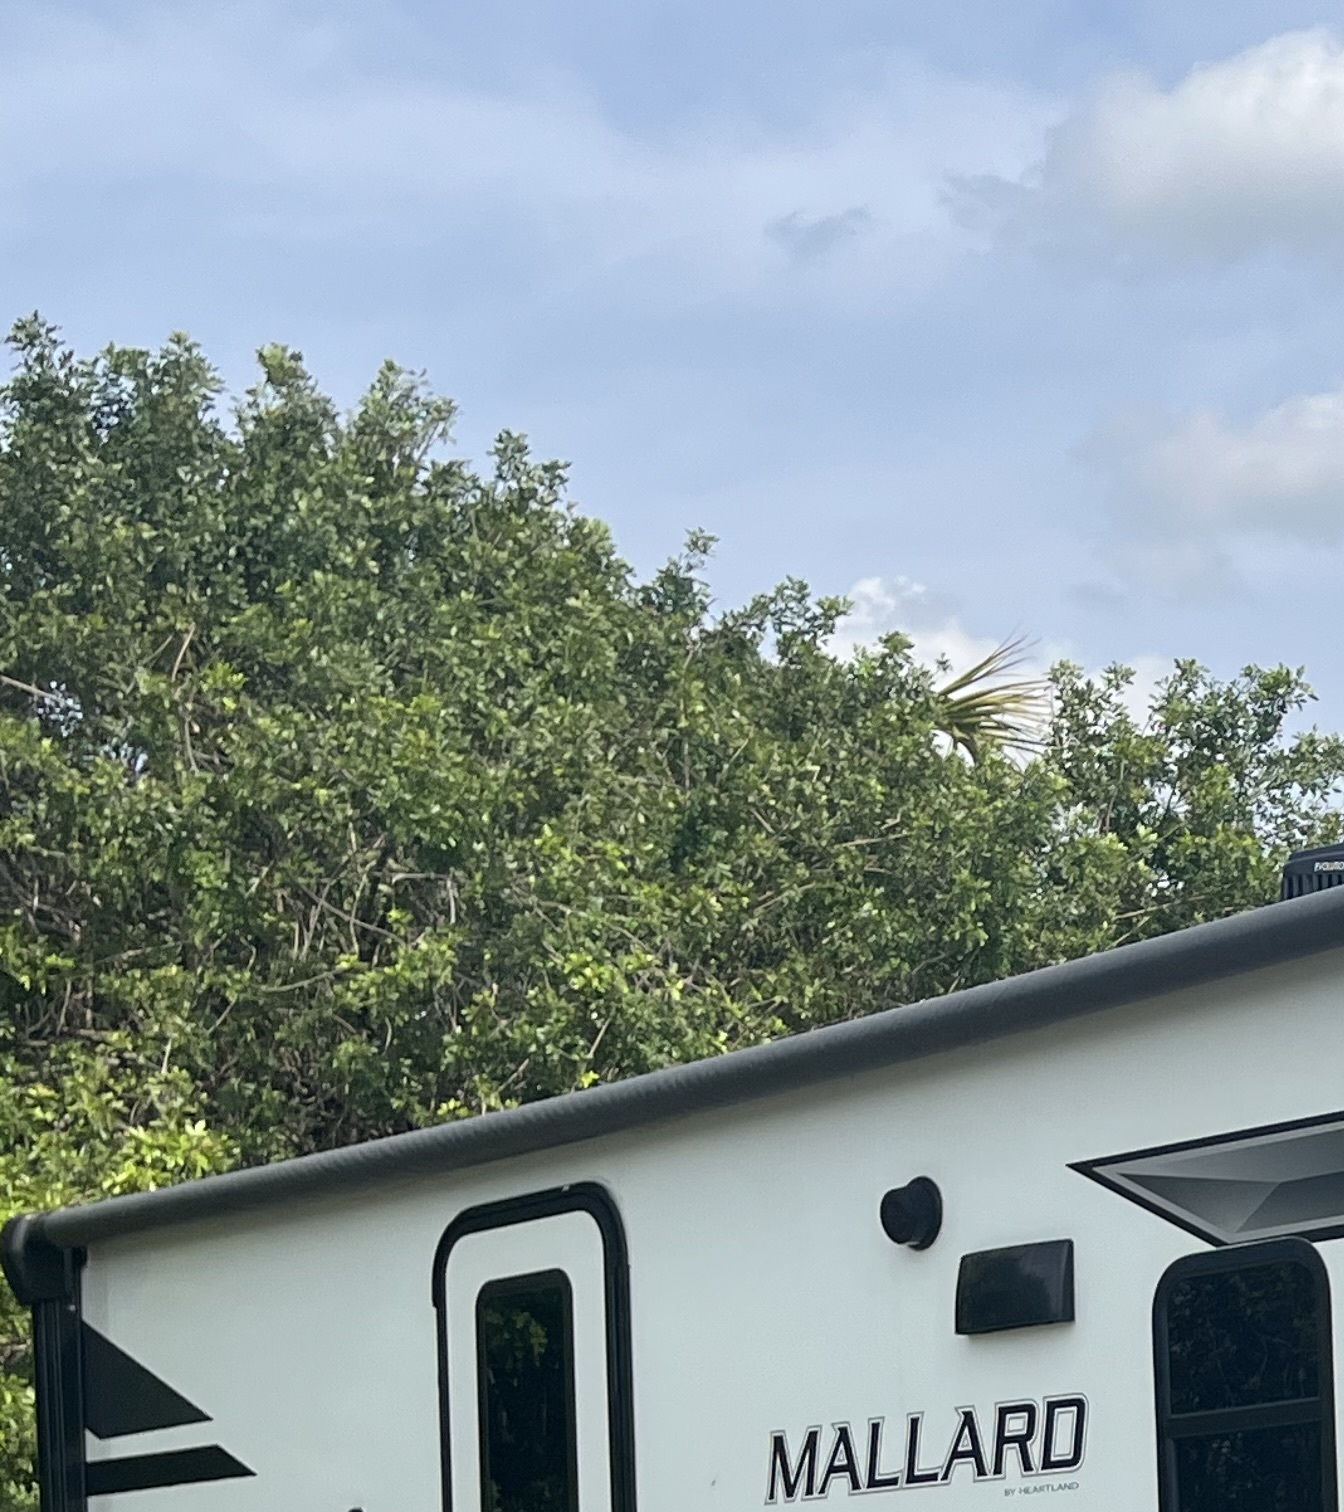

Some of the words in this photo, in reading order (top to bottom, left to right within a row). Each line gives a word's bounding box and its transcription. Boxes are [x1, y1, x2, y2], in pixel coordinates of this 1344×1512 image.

[764, 1392, 1089, 1505] MALLARD
[1004, 1487, 1016, 1497] BY
[1019, 1481, 1080, 1495] HEARTLAND
